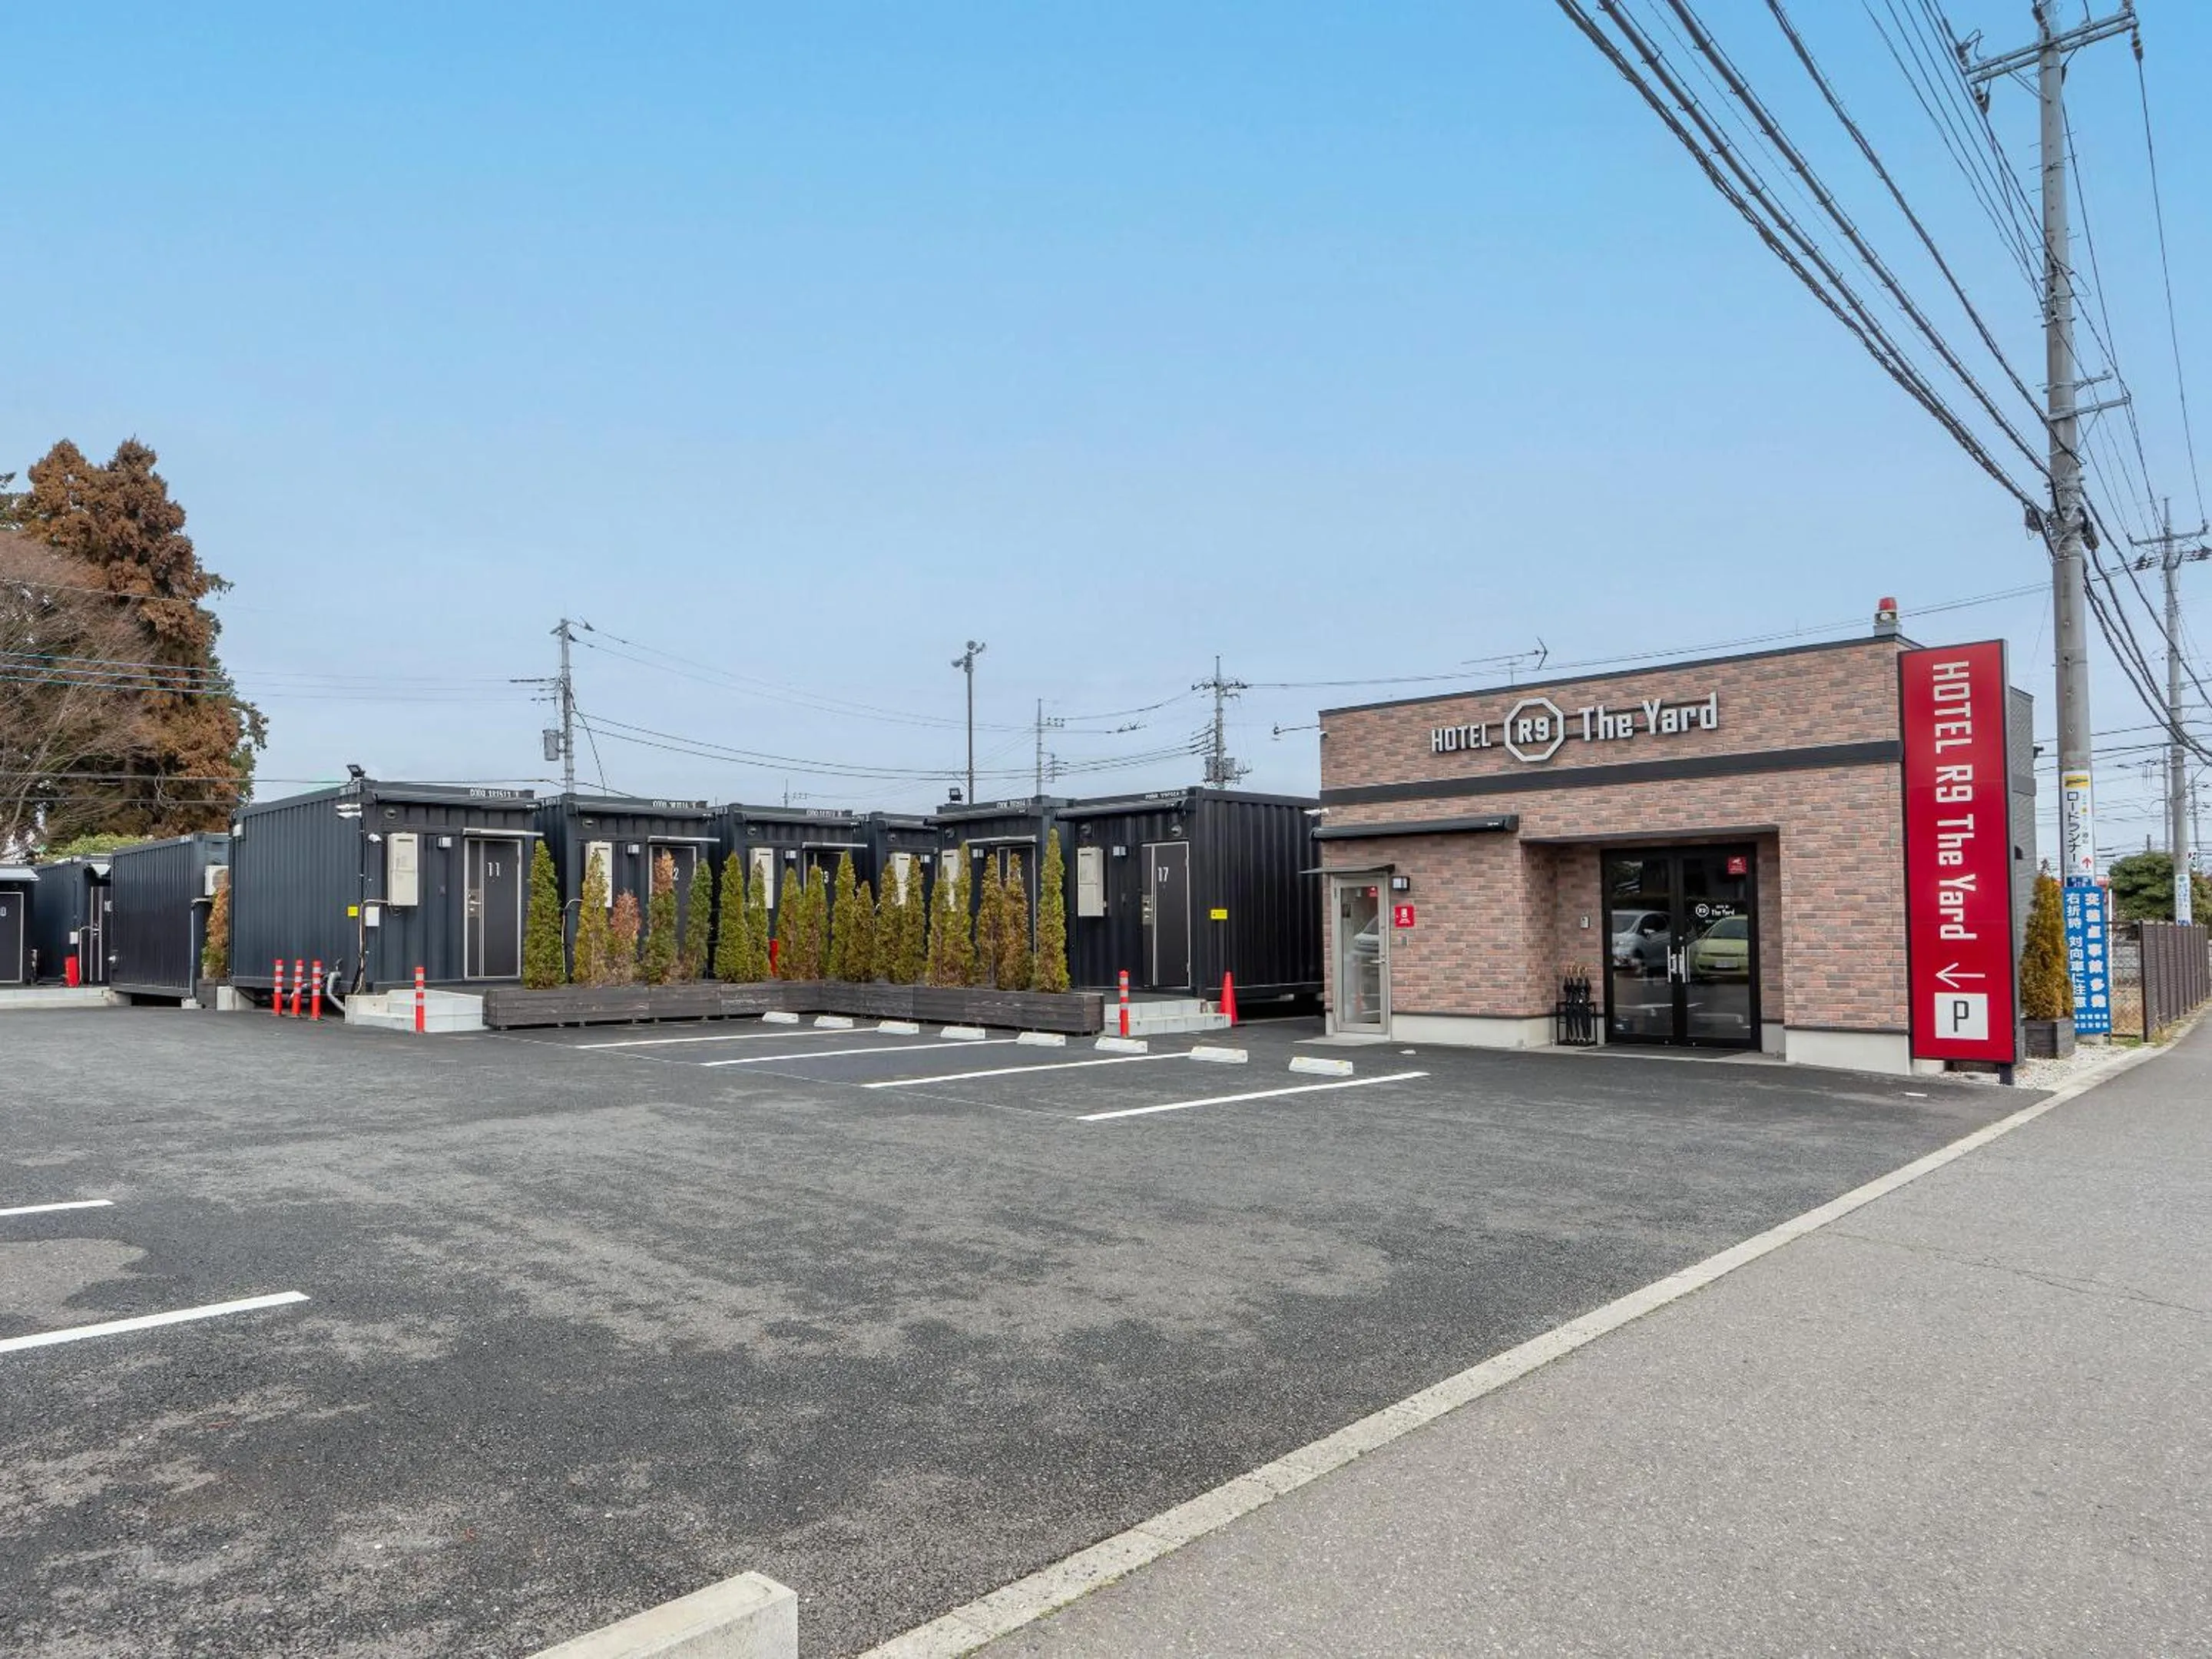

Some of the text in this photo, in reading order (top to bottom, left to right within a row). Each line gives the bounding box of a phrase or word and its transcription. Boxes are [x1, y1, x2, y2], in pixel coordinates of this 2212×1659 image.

[1431, 690, 1718, 753] HOTEL R9 The Yard
[1932, 660, 1978, 941] HOTEL R9 The Yard
[2066, 791, 2081, 863] ロードランナー
[487, 862, 500, 877] 11
[1157, 866, 1169, 882] 17
[2066, 892, 2082, 929] 右折時
[1953, 1000, 1969, 1032] P
